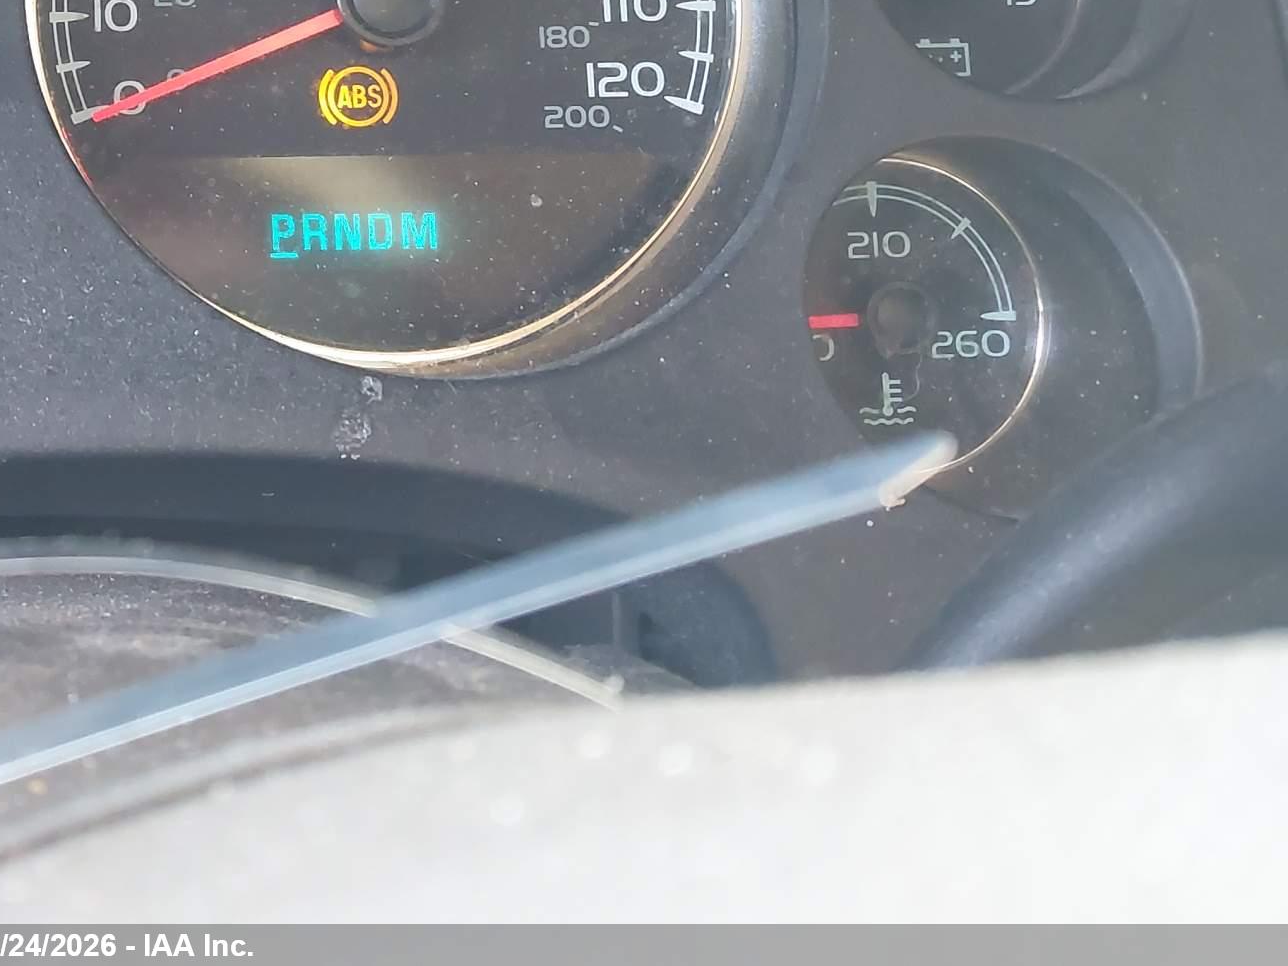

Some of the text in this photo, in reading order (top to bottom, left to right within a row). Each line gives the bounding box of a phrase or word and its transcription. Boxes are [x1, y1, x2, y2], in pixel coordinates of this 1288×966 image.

[539, 25, 590, 49] 180
[586, 62, 666, 98] 120
[338, 85, 381, 109] ABS
[544, 105, 609, 129] 200
[848, 232, 910, 259] 210
[932, 330, 1010, 359] 260
